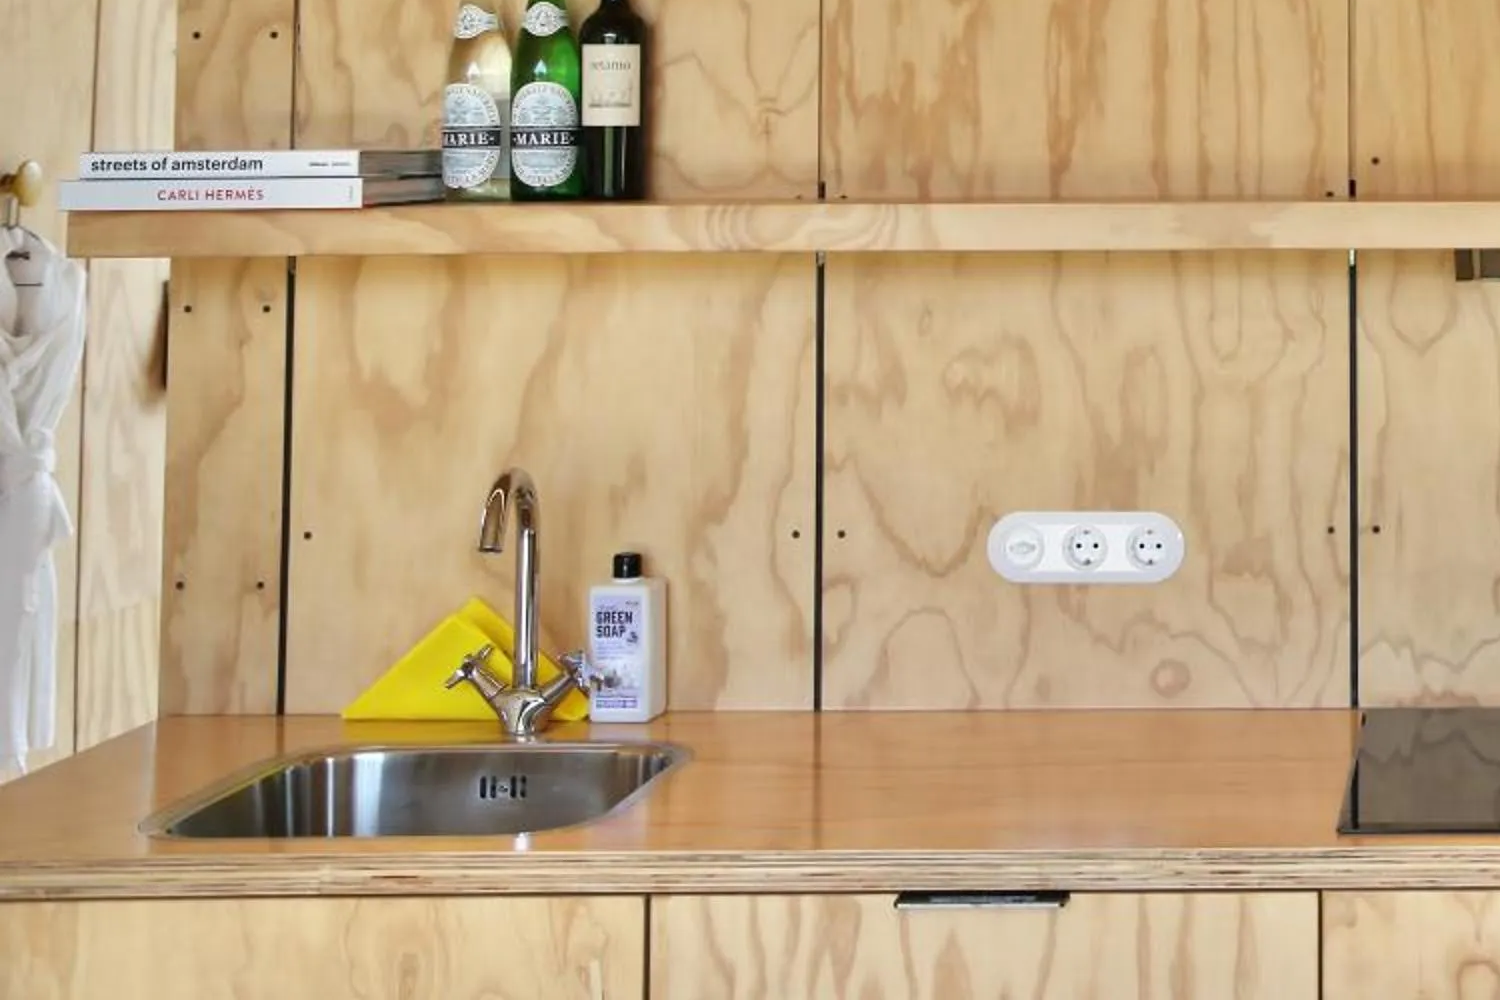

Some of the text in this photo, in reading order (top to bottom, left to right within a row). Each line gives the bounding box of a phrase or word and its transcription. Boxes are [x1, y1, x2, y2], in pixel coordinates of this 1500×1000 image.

[515, 131, 570, 146] MARIE
[91, 157, 263, 171] streets of amsterdam
[157, 188, 199, 201] CARLI
[596, 611, 633, 625] GREEN
[596, 625, 626, 638] SOAP
